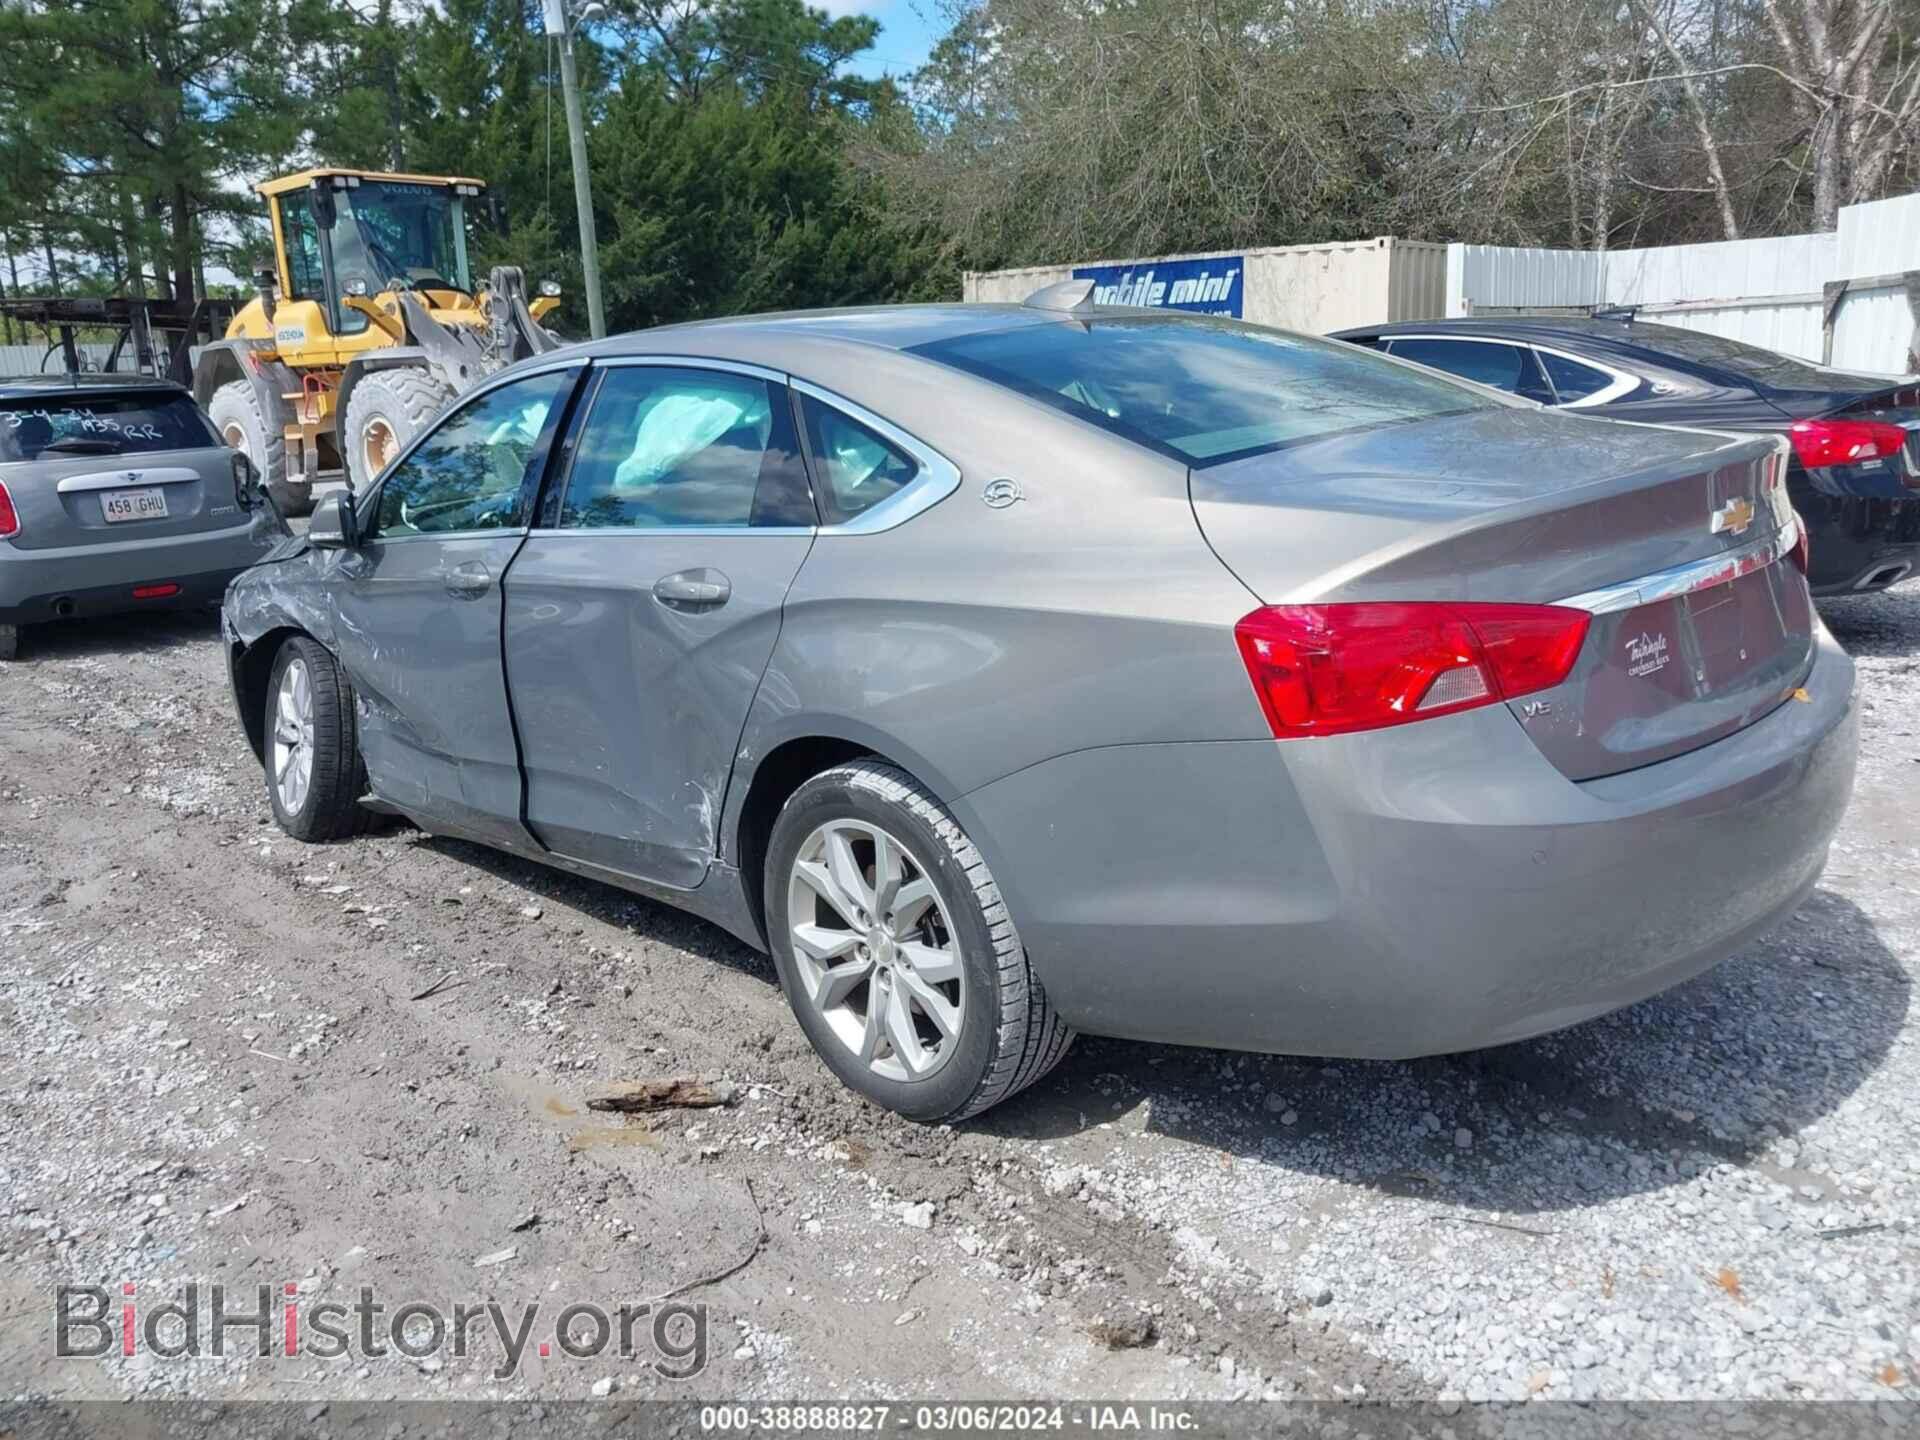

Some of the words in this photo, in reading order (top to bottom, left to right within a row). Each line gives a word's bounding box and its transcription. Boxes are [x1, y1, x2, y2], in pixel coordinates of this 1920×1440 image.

[379, 184, 433, 196] VOLVO
[1168, 270, 1235, 304] mini
[123, 424, 163, 440] RR
[108, 499, 132, 514] 458
[139, 495, 164, 512] GHU
